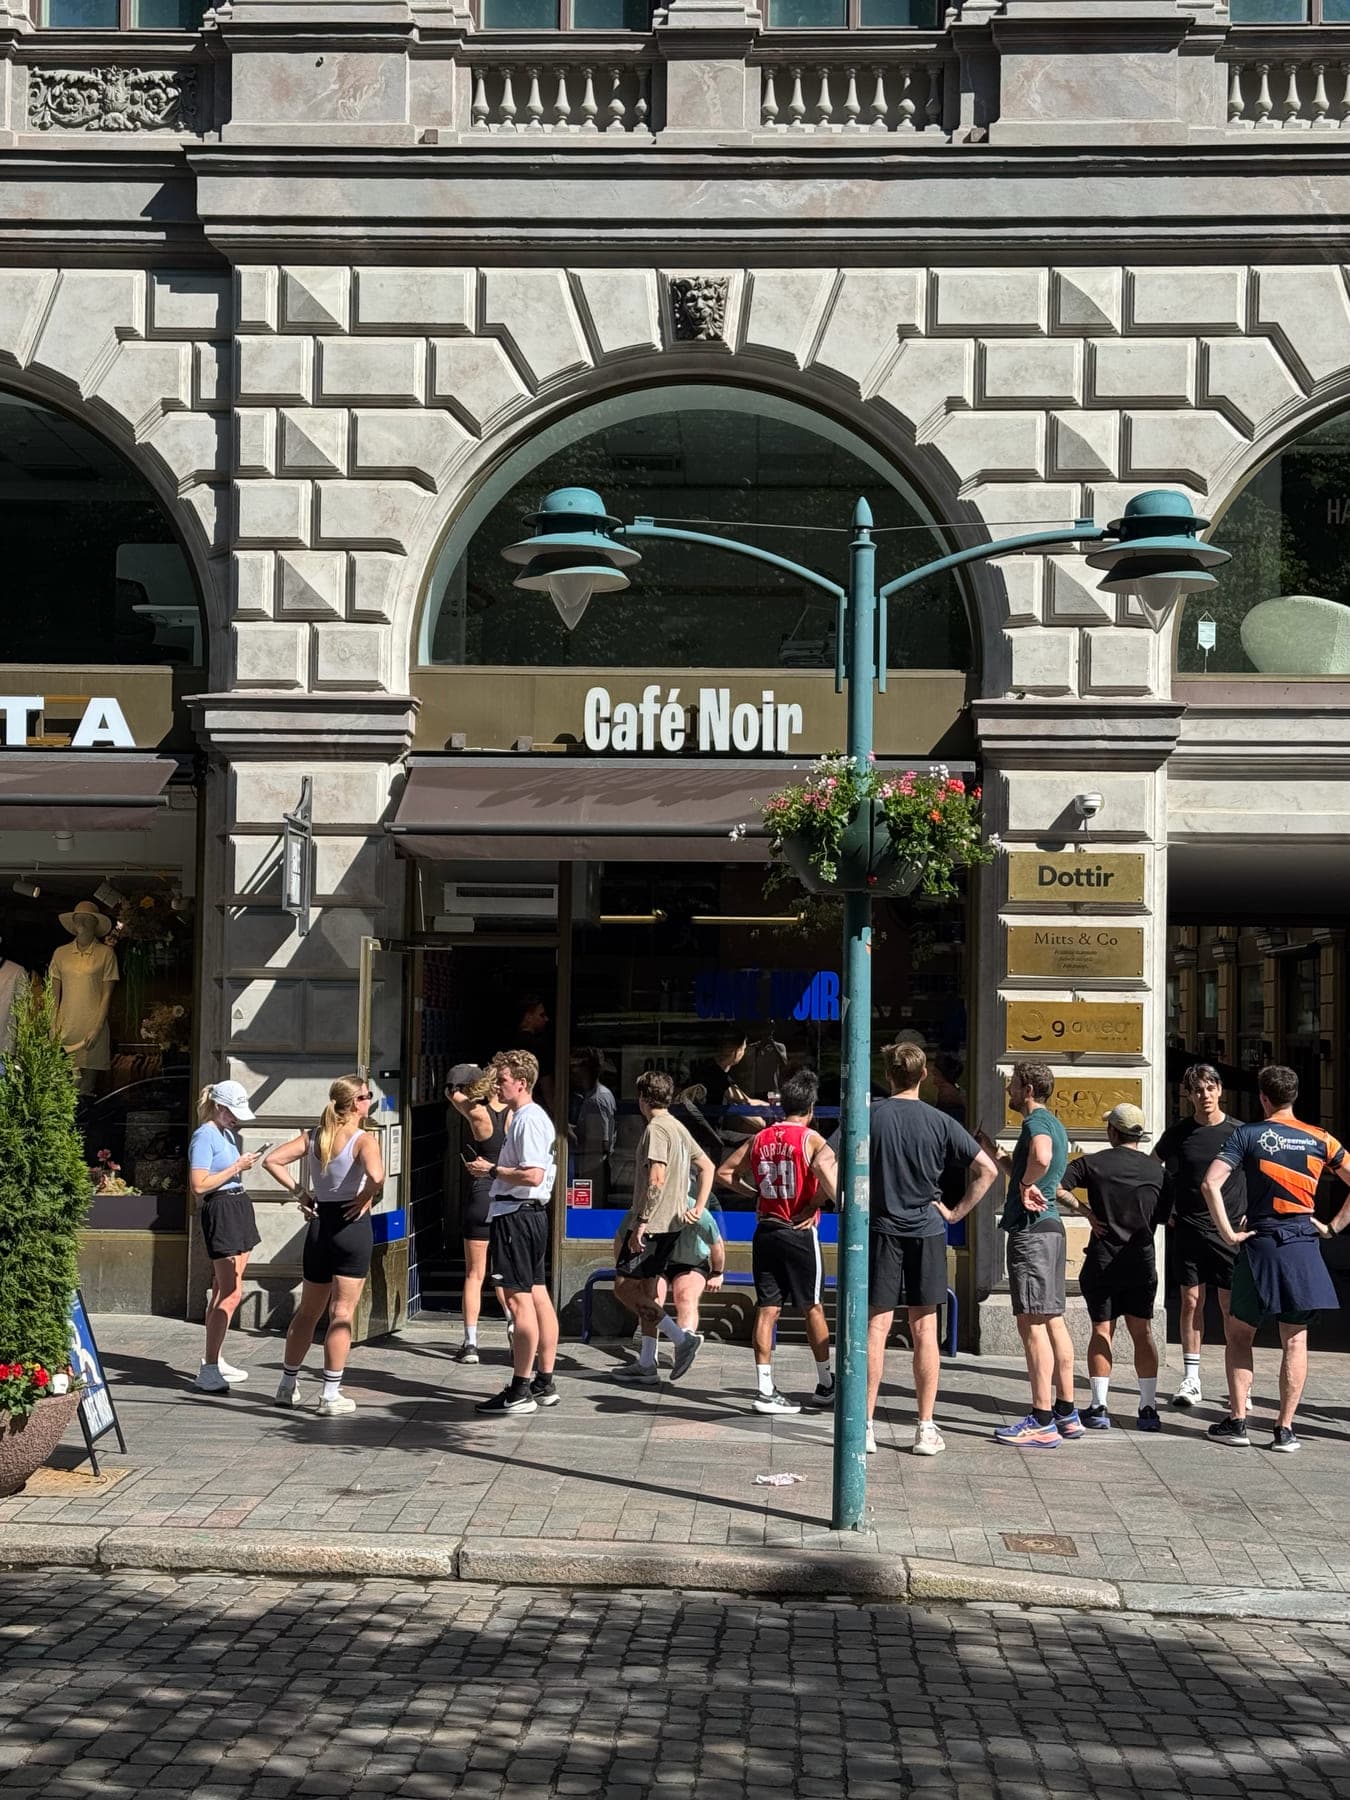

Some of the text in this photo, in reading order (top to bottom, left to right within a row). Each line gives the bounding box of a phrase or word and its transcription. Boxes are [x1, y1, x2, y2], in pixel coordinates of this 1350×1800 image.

[584, 685, 803, 752] Café Noir
[1038, 865, 1115, 888] Dottir
[1034, 932, 1118, 946] Mitts & Co
[1278, 1136, 1318, 1147] Greenwich
[1279, 1143, 1306, 1151] Tritons
[759, 1142, 797, 1161] JORDAN
[757, 1160, 797, 1199] 23
